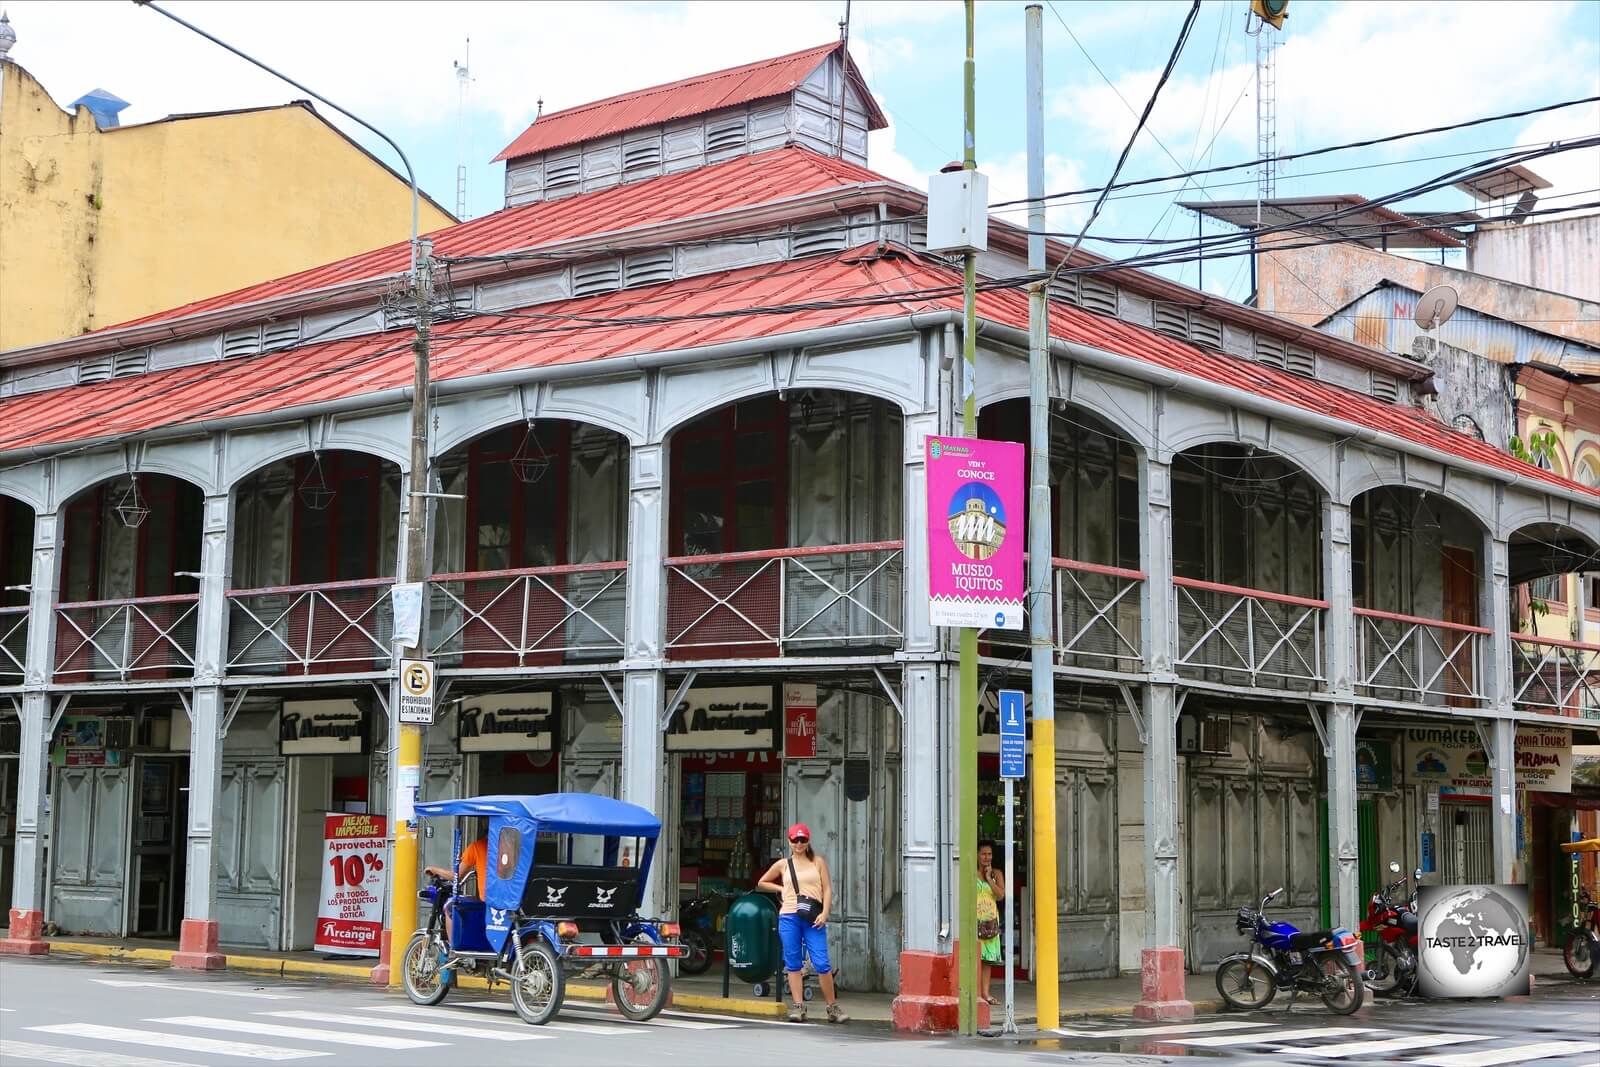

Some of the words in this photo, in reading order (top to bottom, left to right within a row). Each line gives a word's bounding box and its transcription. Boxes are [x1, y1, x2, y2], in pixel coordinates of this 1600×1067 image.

[967, 460, 980, 468] VEN
[957, 469, 995, 480] CONOCE
[951, 562, 993, 577] MUSEO
[955, 576, 1003, 592] IQUITOS
[411, 669, 422, 688] E
[401, 695, 432, 705] PROHIBIDO
[401, 705, 432, 714] ESTACIONAR
[1408, 728, 1483, 743] CUMACEB
[1539, 733, 1566, 747] TOURS
[342, 815, 371, 827] MEJOR
[335, 825, 379, 837] IMPOSIBLE
[328, 840, 386, 852] Aprovecha!
[329, 852, 384, 887] 10%
[347, 890, 369, 898] TODOS
[339, 897, 378, 905] PRODUCTOS
[323, 921, 376, 942] Arcángel
